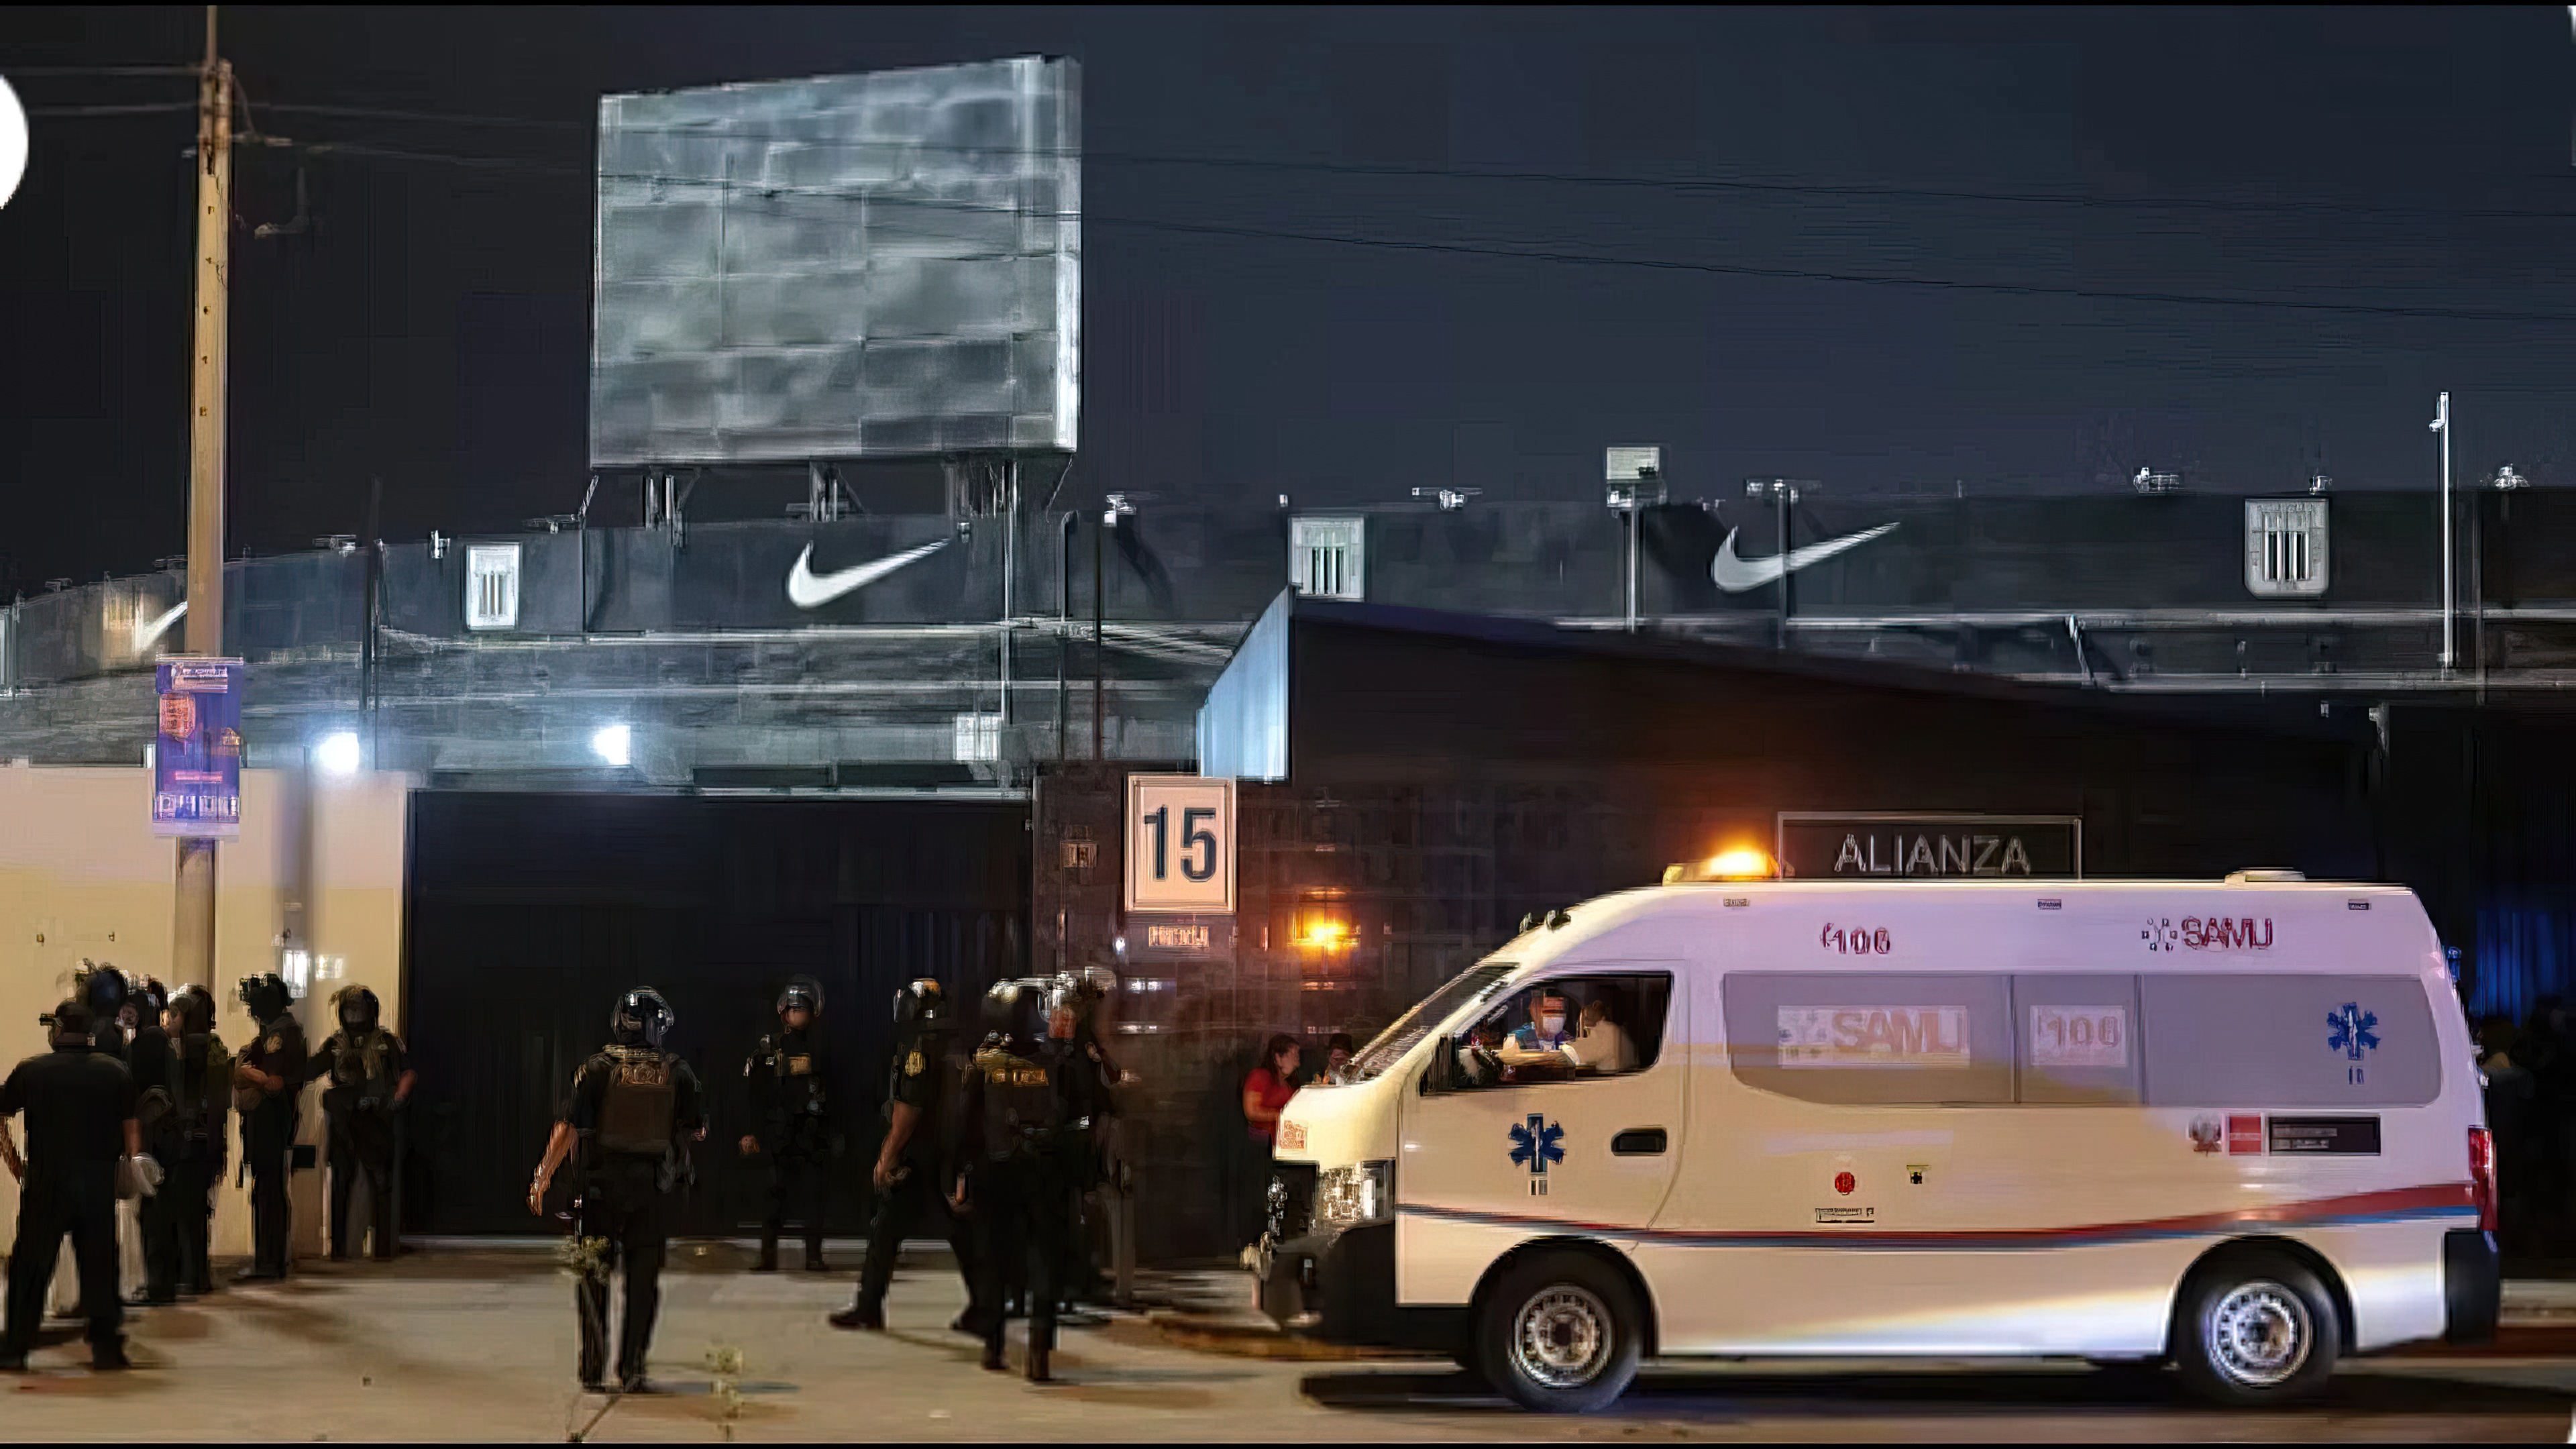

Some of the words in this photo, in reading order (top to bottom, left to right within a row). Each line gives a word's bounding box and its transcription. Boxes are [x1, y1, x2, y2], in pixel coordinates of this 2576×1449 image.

[1144, 806, 1216, 882] 15
[1833, 833, 2031, 873] ALIANZA
[2182, 916, 2273, 949] SAMU
[1832, 1010, 1963, 1053] SAMU
